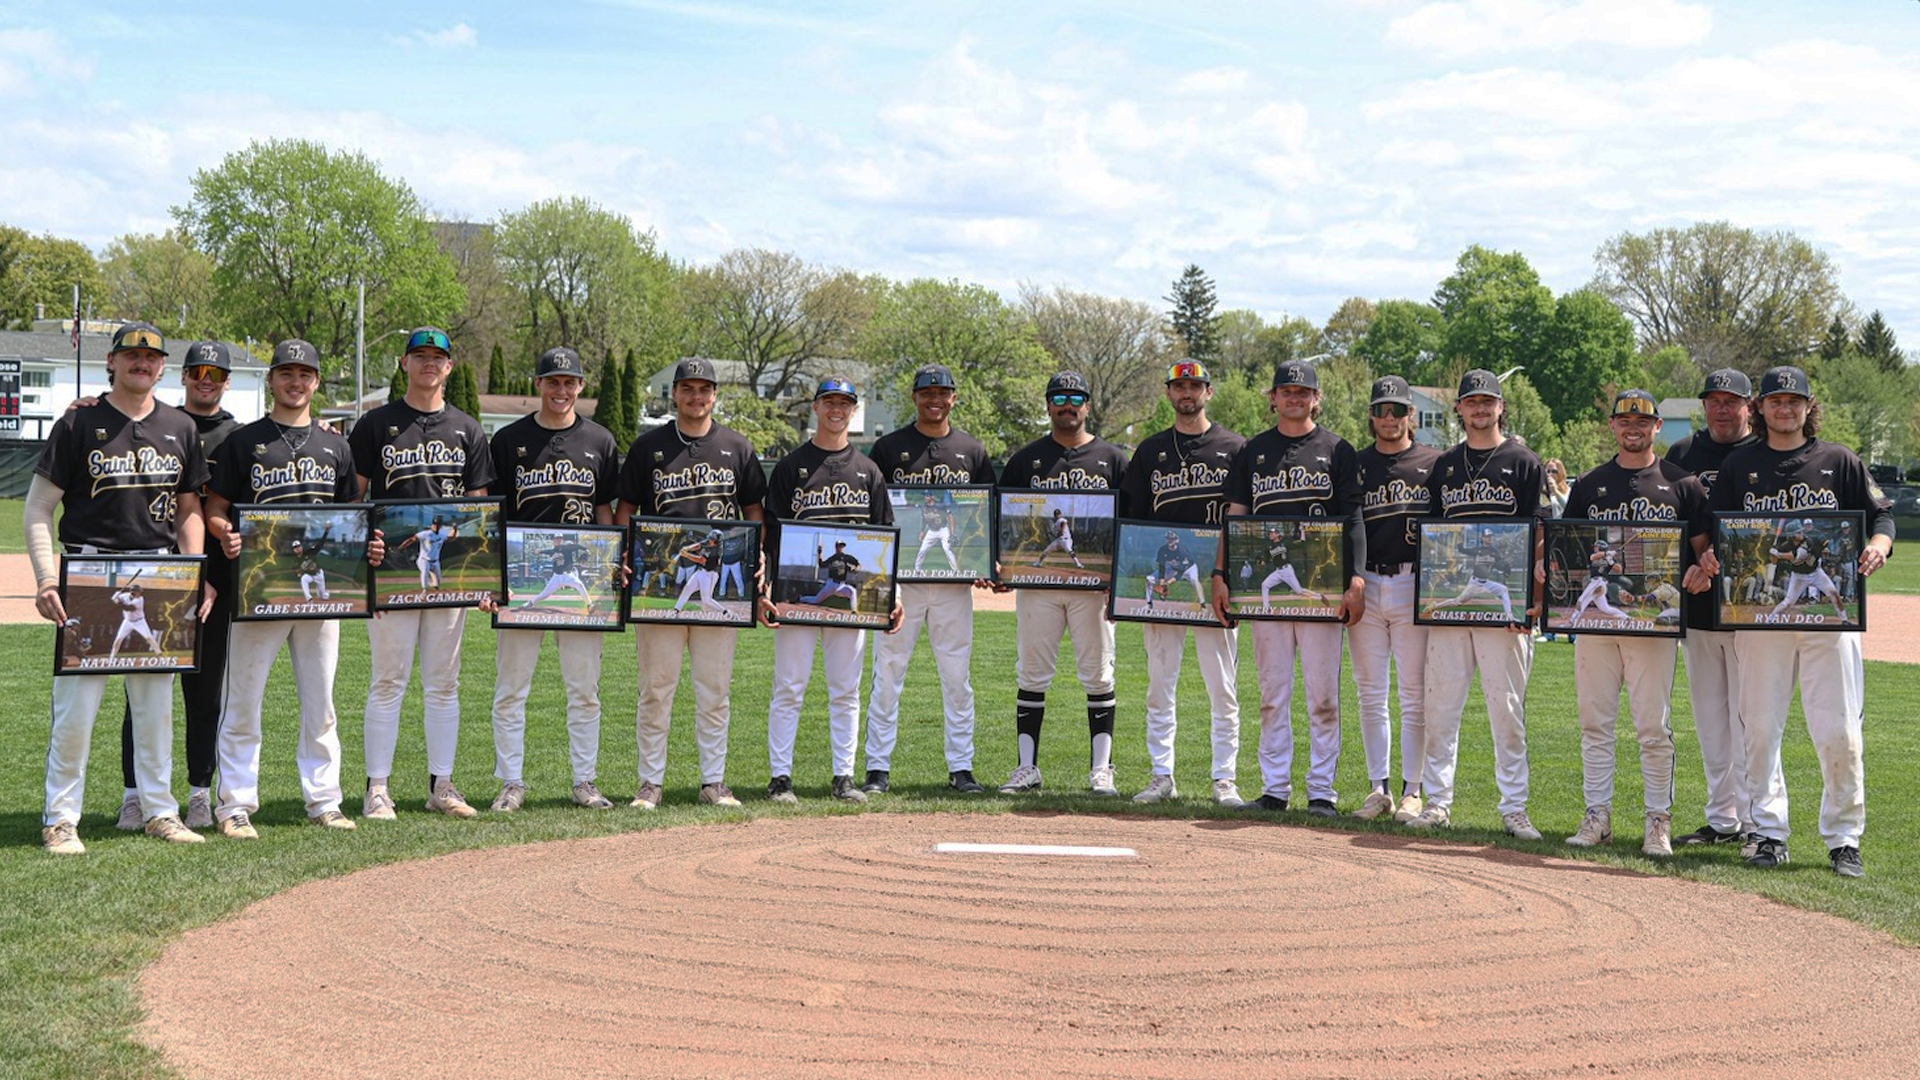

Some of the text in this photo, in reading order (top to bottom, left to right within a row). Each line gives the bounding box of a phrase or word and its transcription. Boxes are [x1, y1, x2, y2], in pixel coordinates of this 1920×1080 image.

[88, 446, 181, 478] Saint Rose
[382, 440, 466, 470] Saint Rose
[251, 456, 335, 491] Saint Rose
[515, 459, 595, 490] Saint Rose
[653, 462, 735, 494] Saint Rose
[893, 464, 971, 484] Saint Rose
[1030, 467, 1109, 489] Saint Rose
[1150, 467, 1189, 494] Saint
[1252, 465, 1331, 497] Saint Rose
[791, 482, 870, 512] Saint Rose
[1388, 479, 1431, 503] Rose
[1471, 478, 1515, 504] Rose
[1743, 482, 1838, 511] Saint Rose
[1587, 497, 1677, 520] Saint Rose
[931, 569, 977, 578] FOWLER
[1011, 574, 1101, 586] RANDALL ALEJO
[388, 591, 491, 604] ZACK GAMACHE
[255, 603, 354, 614] GABE STEWART
[786, 610, 880, 623] CHASE CARROLL
[1129, 607, 1216, 621] THOMAS KRILL
[1240, 605, 1335, 616] AVERY MOSSEAU
[1431, 610, 1514, 621] CHASE TUCKER
[1754, 614, 1825, 623] RYAN DEO
[515, 614, 605, 625] THOMAS MARK
[1572, 618, 1654, 630] JAMES WARD
[80, 656, 178, 668] NATHAN TOMS
